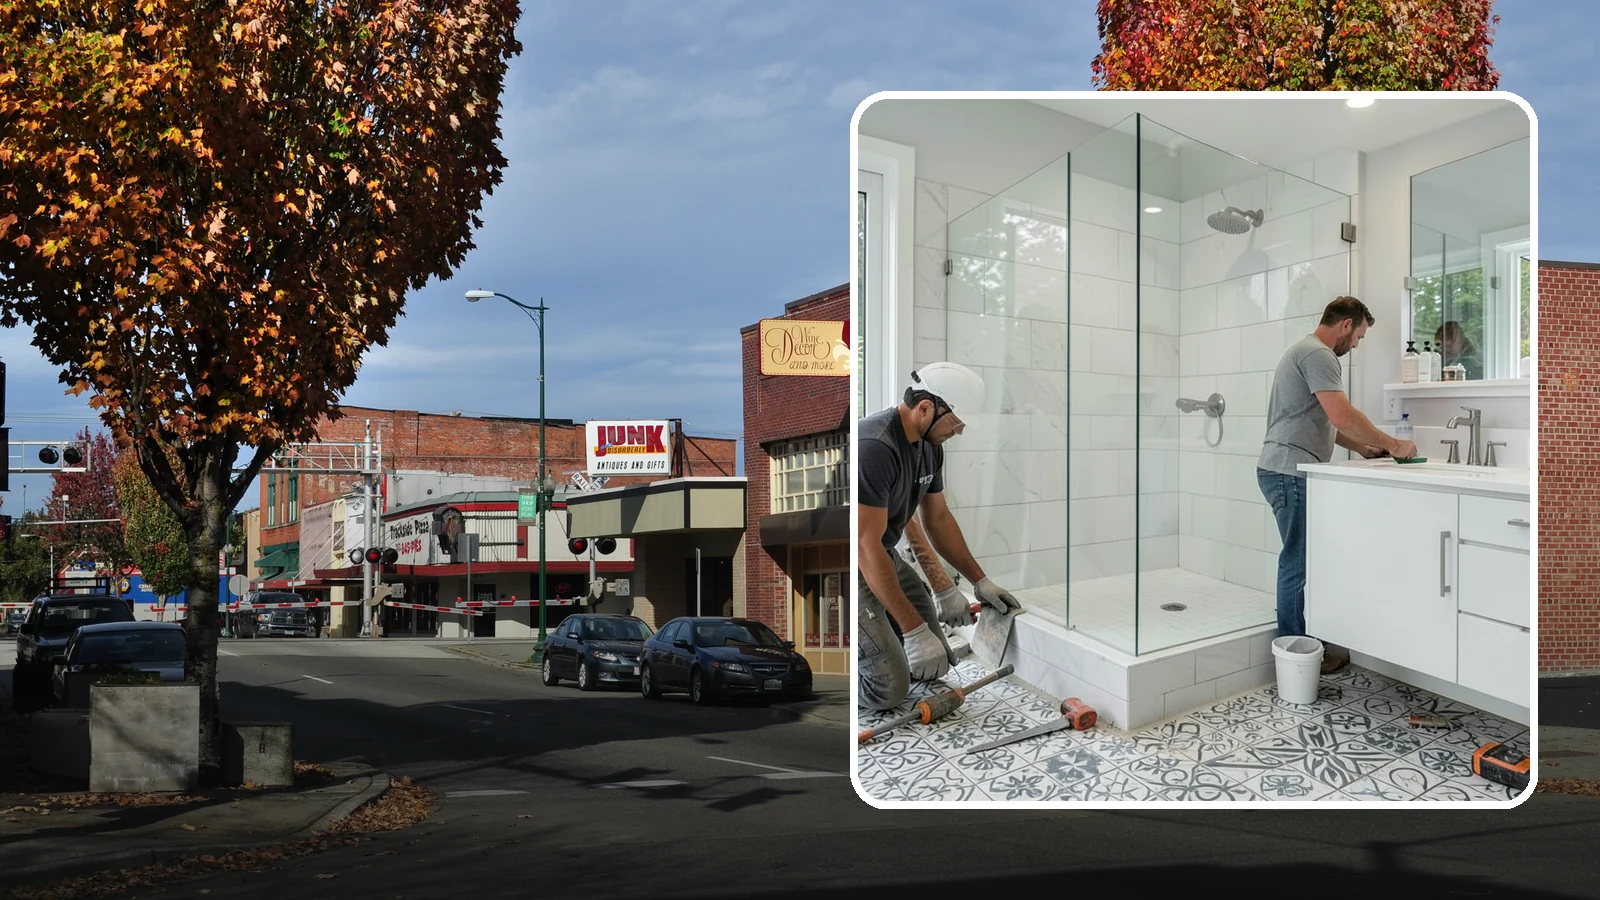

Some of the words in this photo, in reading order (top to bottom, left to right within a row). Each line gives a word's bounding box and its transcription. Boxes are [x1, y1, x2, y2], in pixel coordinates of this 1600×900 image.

[595, 425, 665, 457] JUNK
[607, 446, 646, 454] DISORDERLY
[597, 461, 628, 470] ANTIQUES
[631, 461, 644, 470] AND
[647, 460, 665, 470] GIFTS
[352, 498, 364, 511] CRO
[390, 521, 413, 540] Trackside
[414, 519, 429, 535] Pizza
